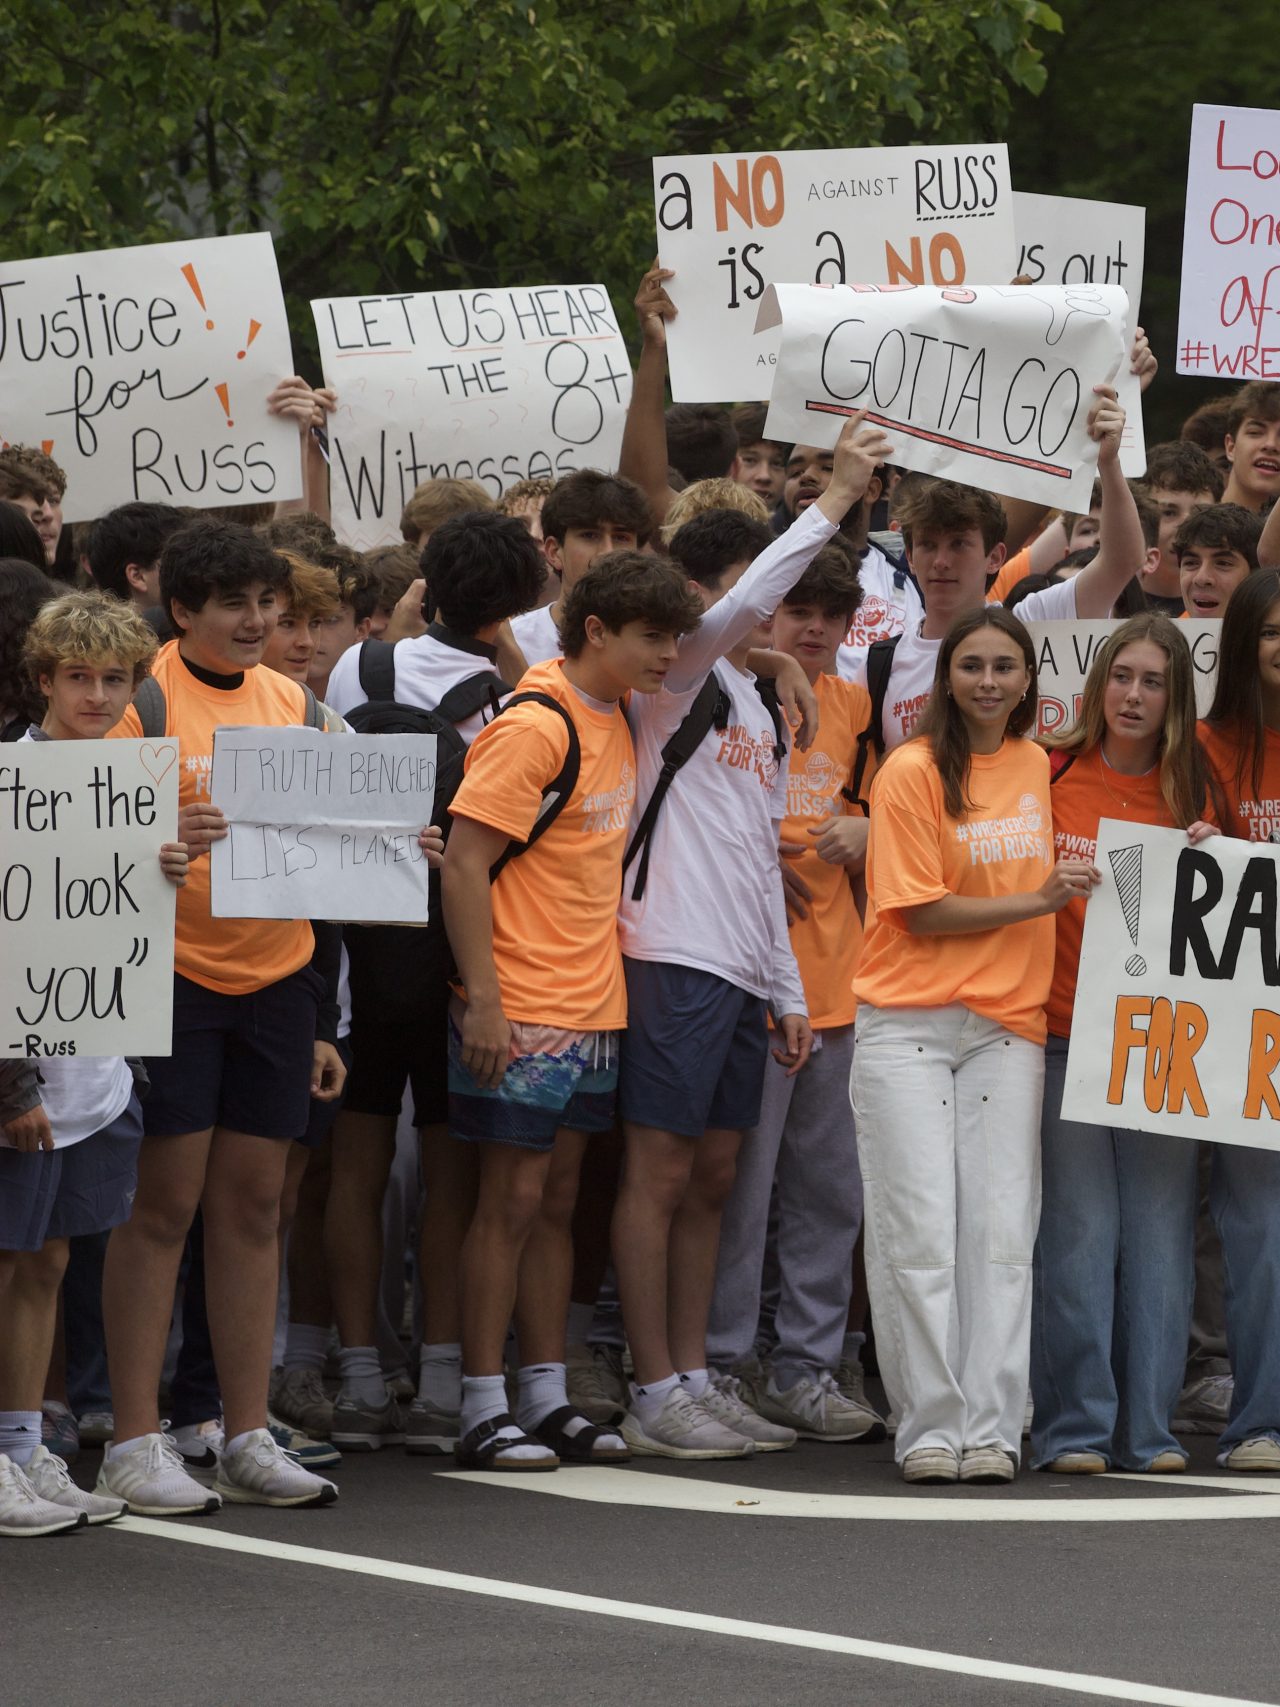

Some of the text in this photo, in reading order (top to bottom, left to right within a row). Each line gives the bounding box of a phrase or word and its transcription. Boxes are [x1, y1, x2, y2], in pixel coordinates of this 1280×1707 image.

[659, 155, 999, 232] a NO AGAINST RUSS
[718, 231, 966, 309] is a NO
[1062, 240, 1128, 284] out
[328, 287, 617, 350] LET US HEAR
[46, 366, 209, 457] for
[427, 341, 628, 444] THE 8+
[820, 318, 1081, 457] GOTTA GO
[132, 428, 276, 500] Russ
[221, 748, 333, 795] TRUTH
[350, 752, 437, 795] BENCHED
[716, 741, 752, 771] FOR
[88, 766, 157, 829] the
[956, 816, 1028, 842] #WRECKERS
[230, 824, 424, 881] LIES PLAYED
[969, 838, 1002, 866] FOR
[55, 852, 140, 920] look
[1106, 995, 1210, 1118] FOR
